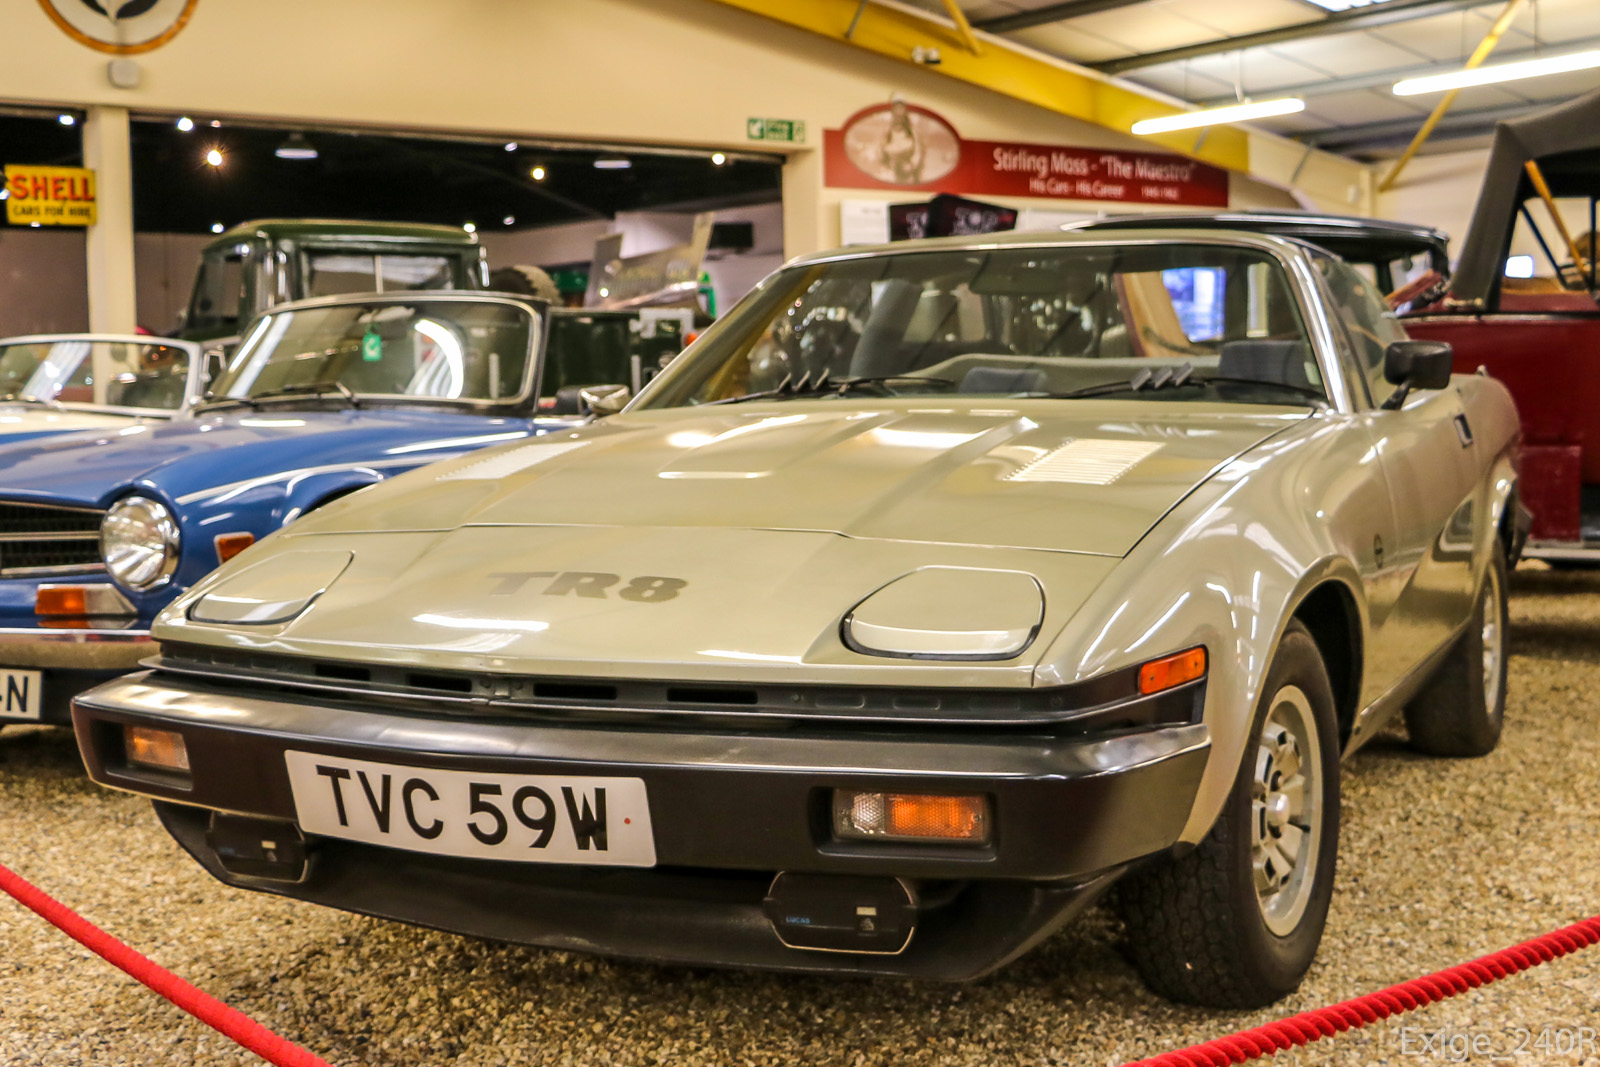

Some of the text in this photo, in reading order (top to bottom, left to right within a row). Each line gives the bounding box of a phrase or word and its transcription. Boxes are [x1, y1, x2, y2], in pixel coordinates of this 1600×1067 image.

[993, 147, 1048, 179] Stirling
[1051, 151, 1089, 177] Moss
[11, 174, 95, 201] SHELL
[487, 571, 689, 604] TR8
[315, 764, 608, 851] TVC 59W
[786, 916, 811, 924] LUCAS
